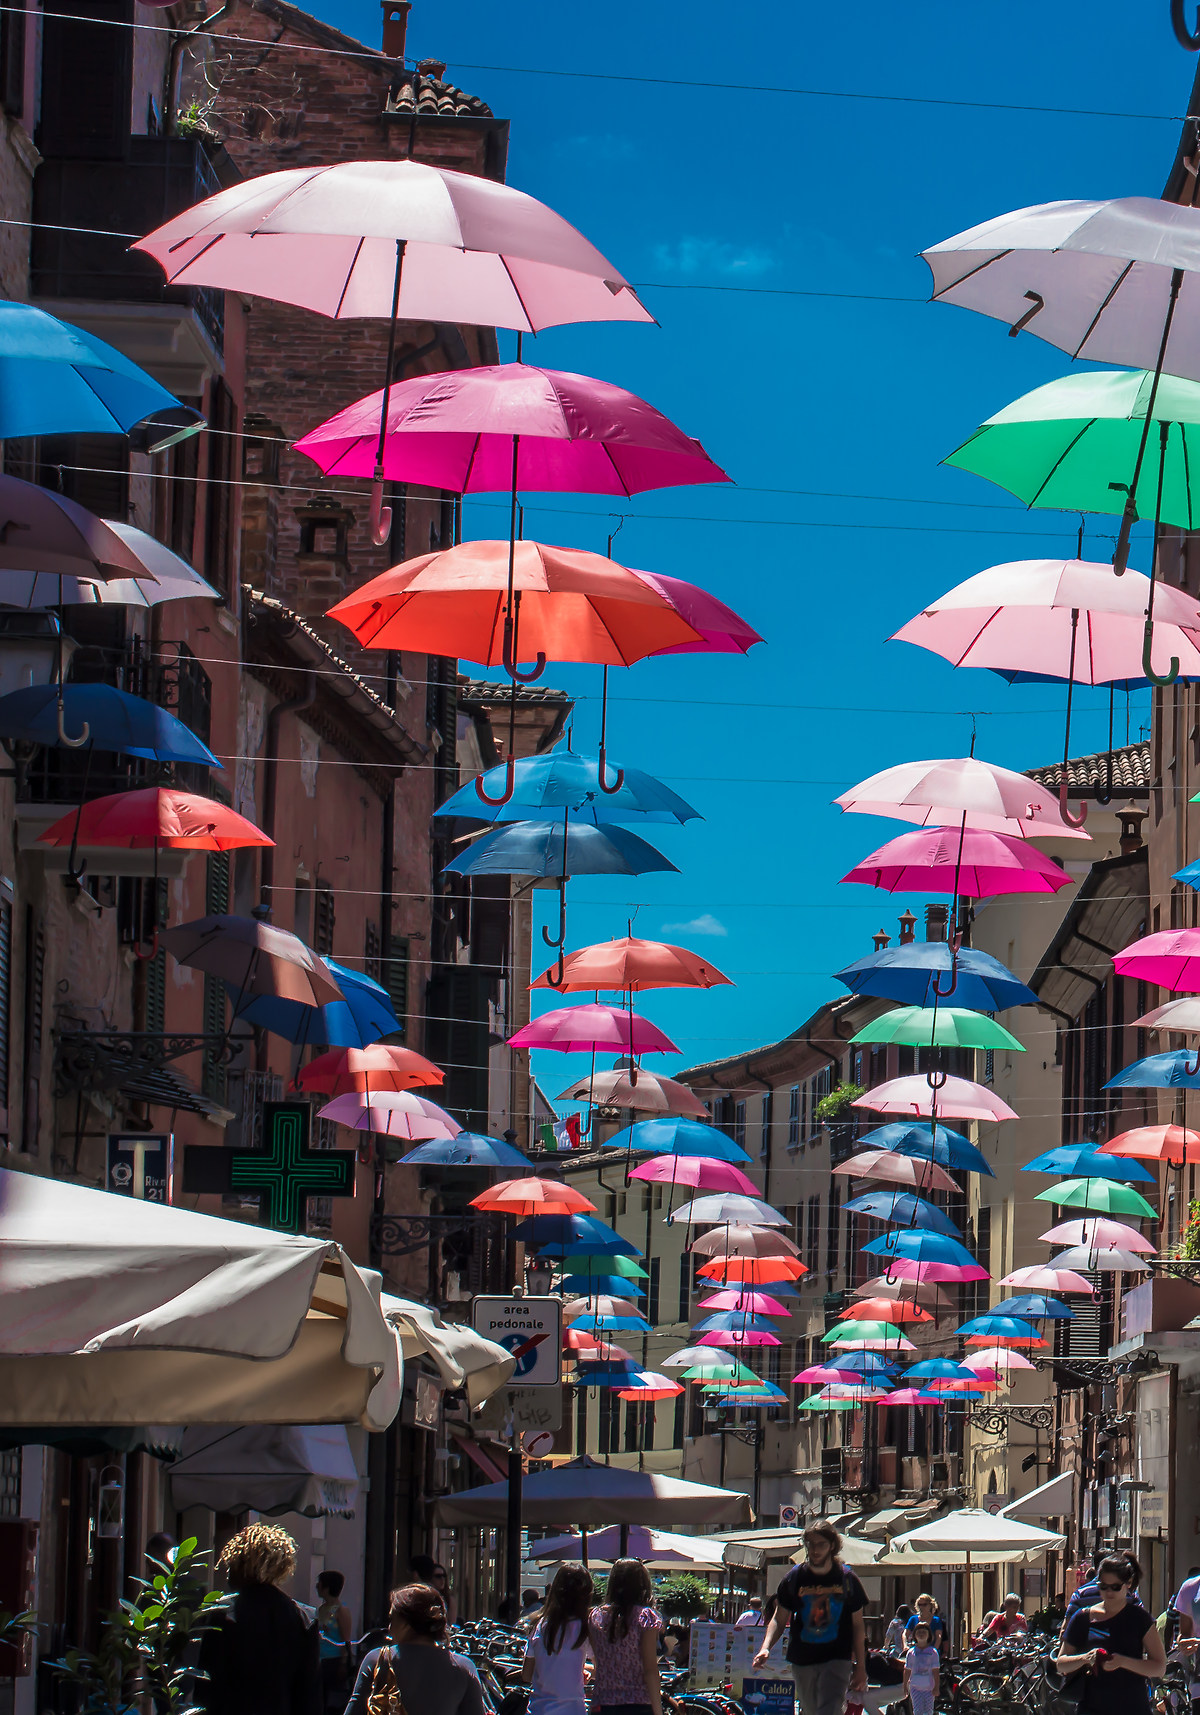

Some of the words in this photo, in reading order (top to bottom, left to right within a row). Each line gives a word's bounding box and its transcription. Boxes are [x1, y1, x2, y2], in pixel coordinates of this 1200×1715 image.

[148, 1188, 164, 1200] 21
[504, 1305, 530, 1315] area
[489, 1319, 544, 1330] pedonale
[761, 1683, 793, 1695] Caldo?
